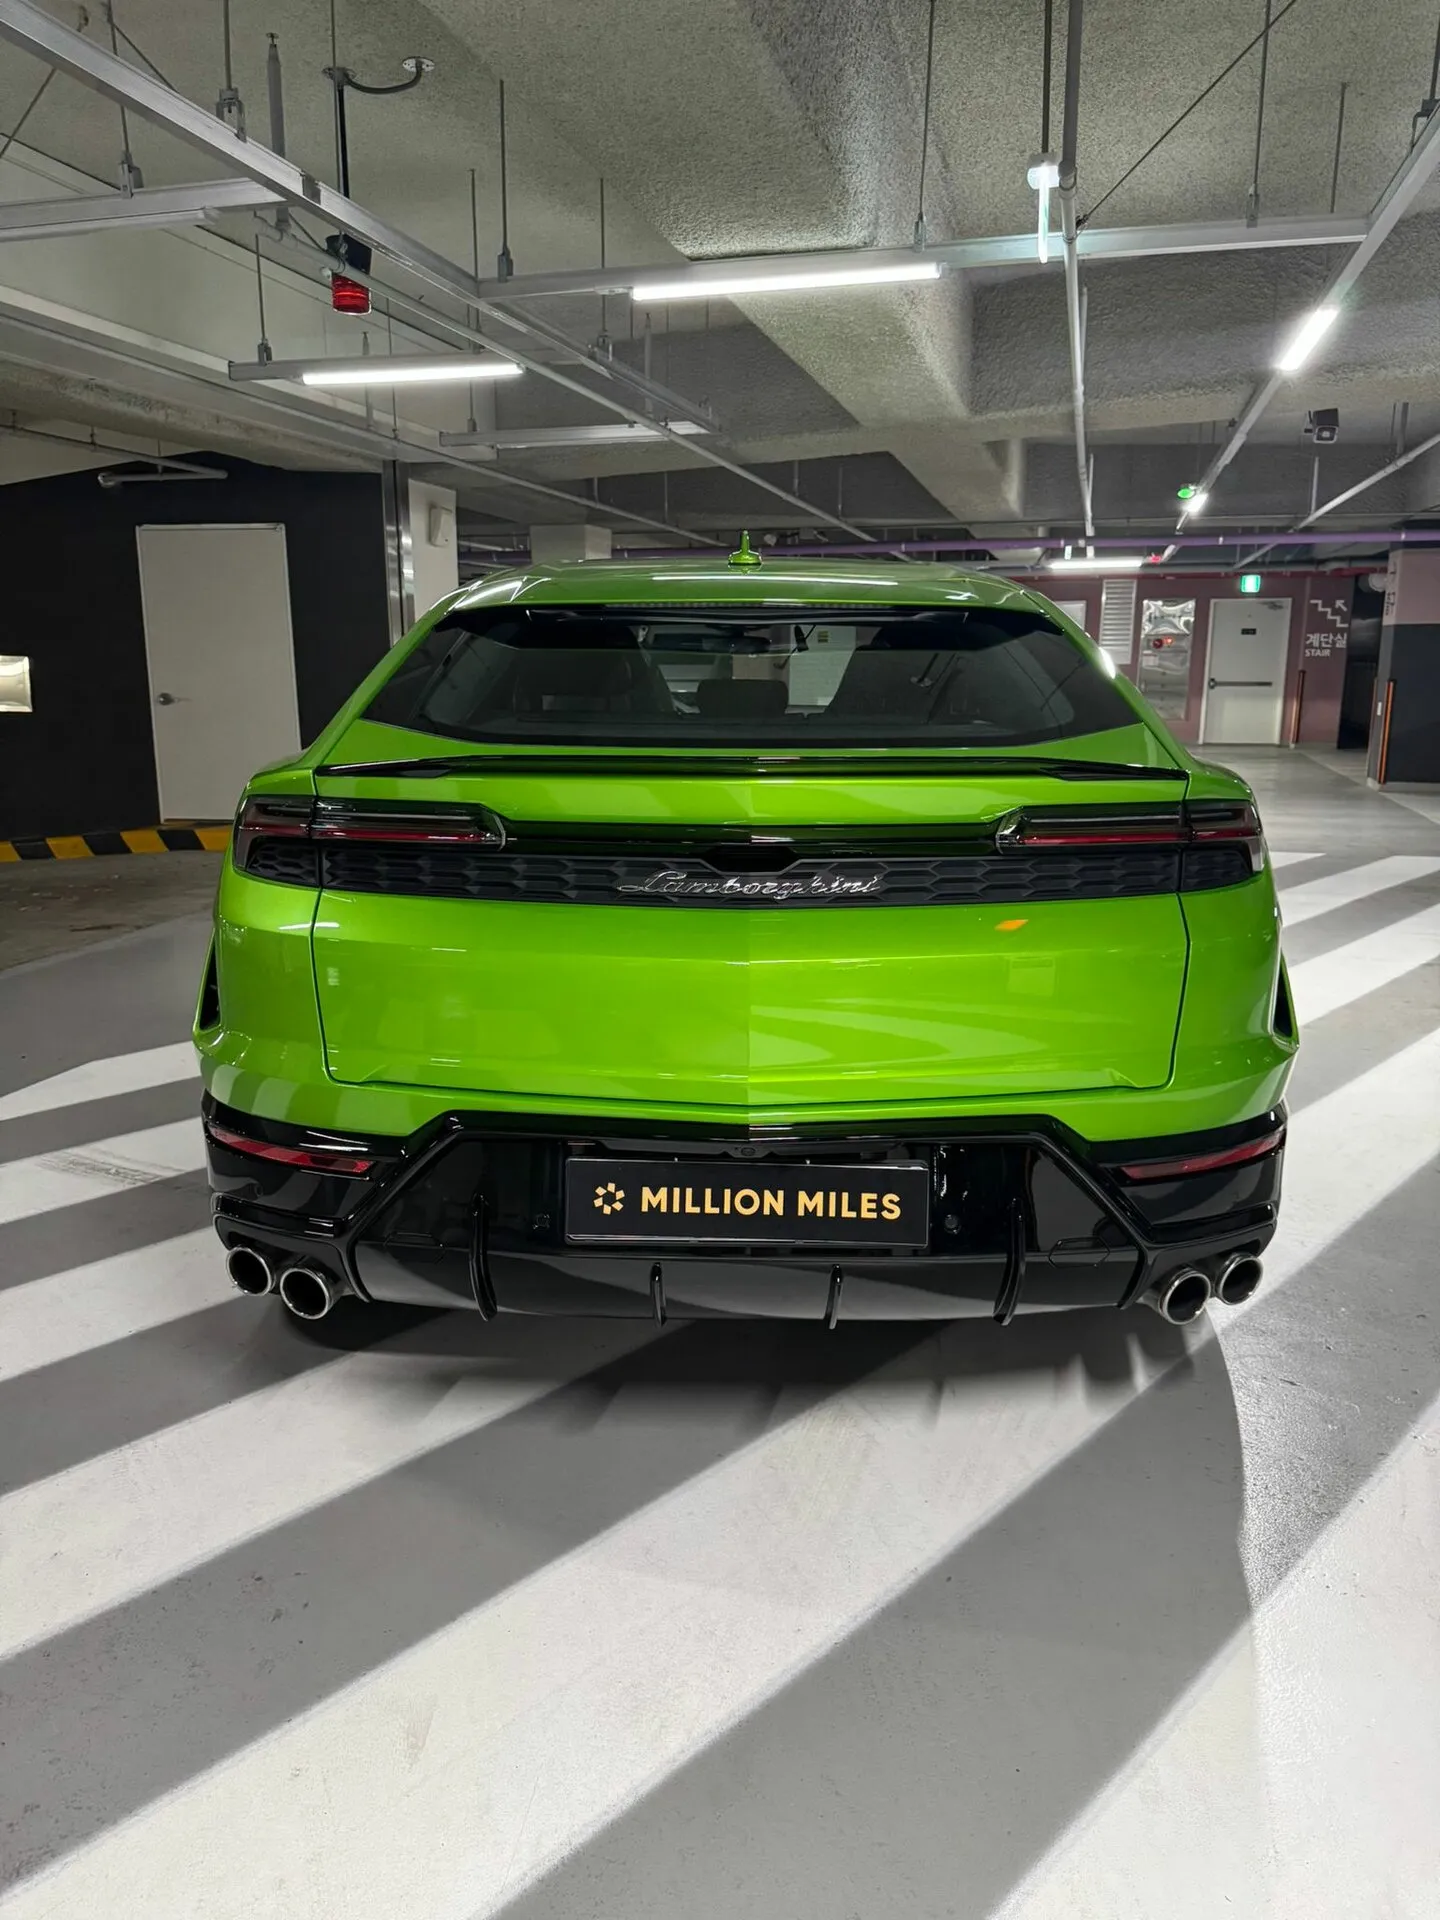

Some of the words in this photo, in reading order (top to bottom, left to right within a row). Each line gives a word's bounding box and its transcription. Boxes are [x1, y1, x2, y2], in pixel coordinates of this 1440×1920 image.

[1305, 632, 1347, 649] 계단실
[1304, 648, 1331, 657] STAIR
[617, 871, 883, 900] Lamborghini
[641, 1187, 785, 1217] MILLION
[797, 1190, 902, 1220] MILES
